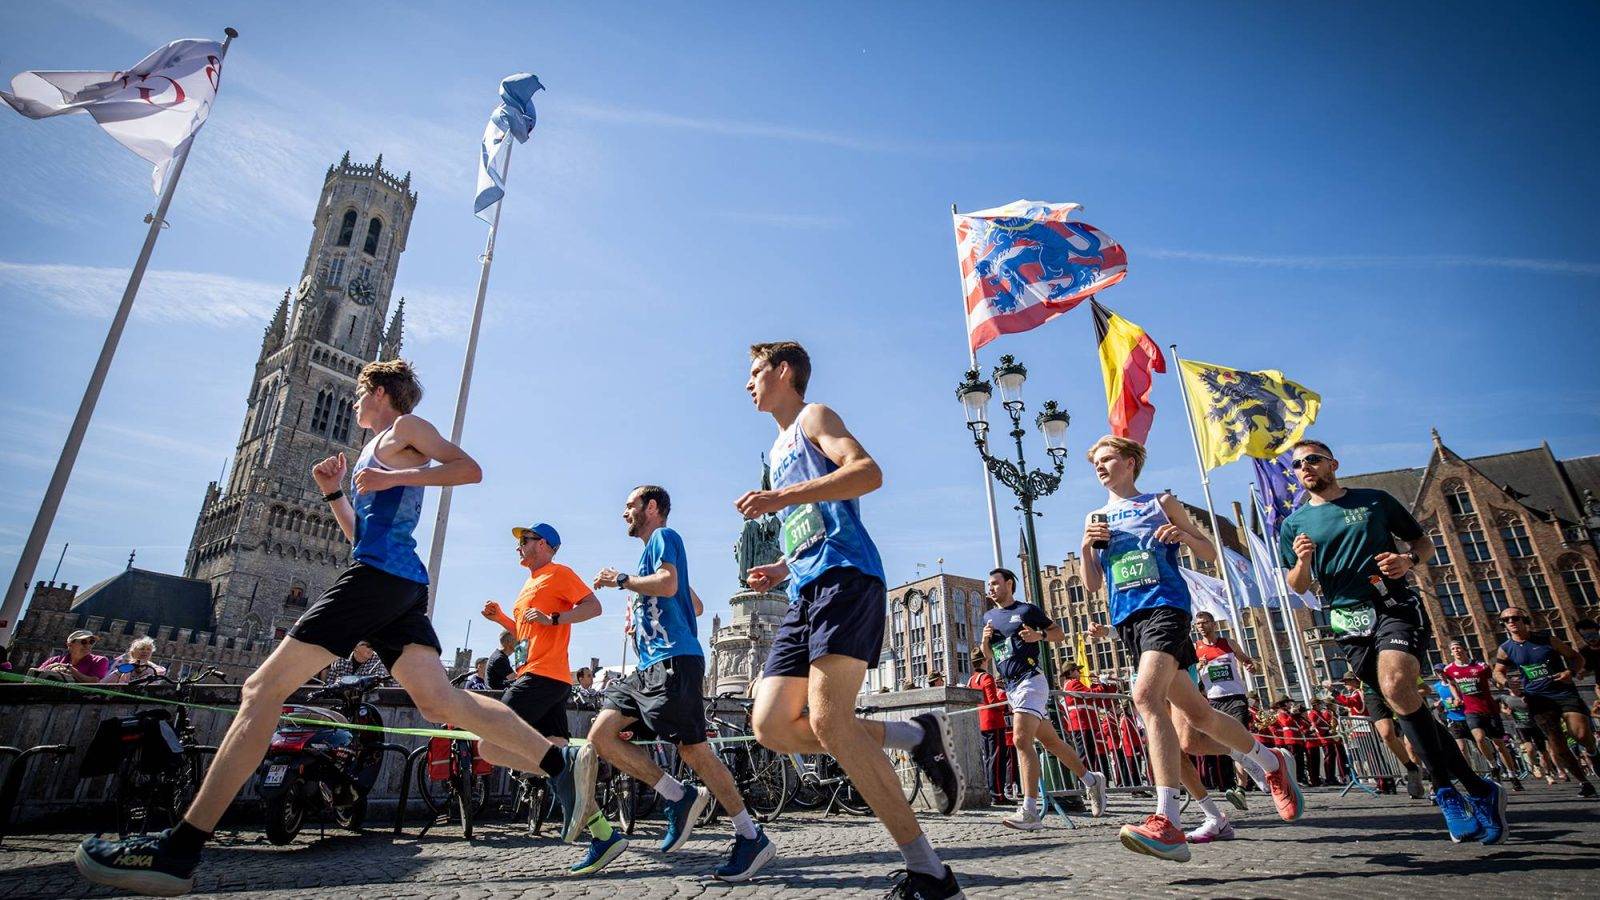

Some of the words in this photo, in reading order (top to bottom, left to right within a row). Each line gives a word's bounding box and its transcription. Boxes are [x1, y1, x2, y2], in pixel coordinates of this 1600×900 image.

[791, 518, 810, 544] 3111
[1121, 562, 1144, 578] 647
[1390, 638, 1408, 646] JAKO
[113, 854, 153, 867] HOKA
